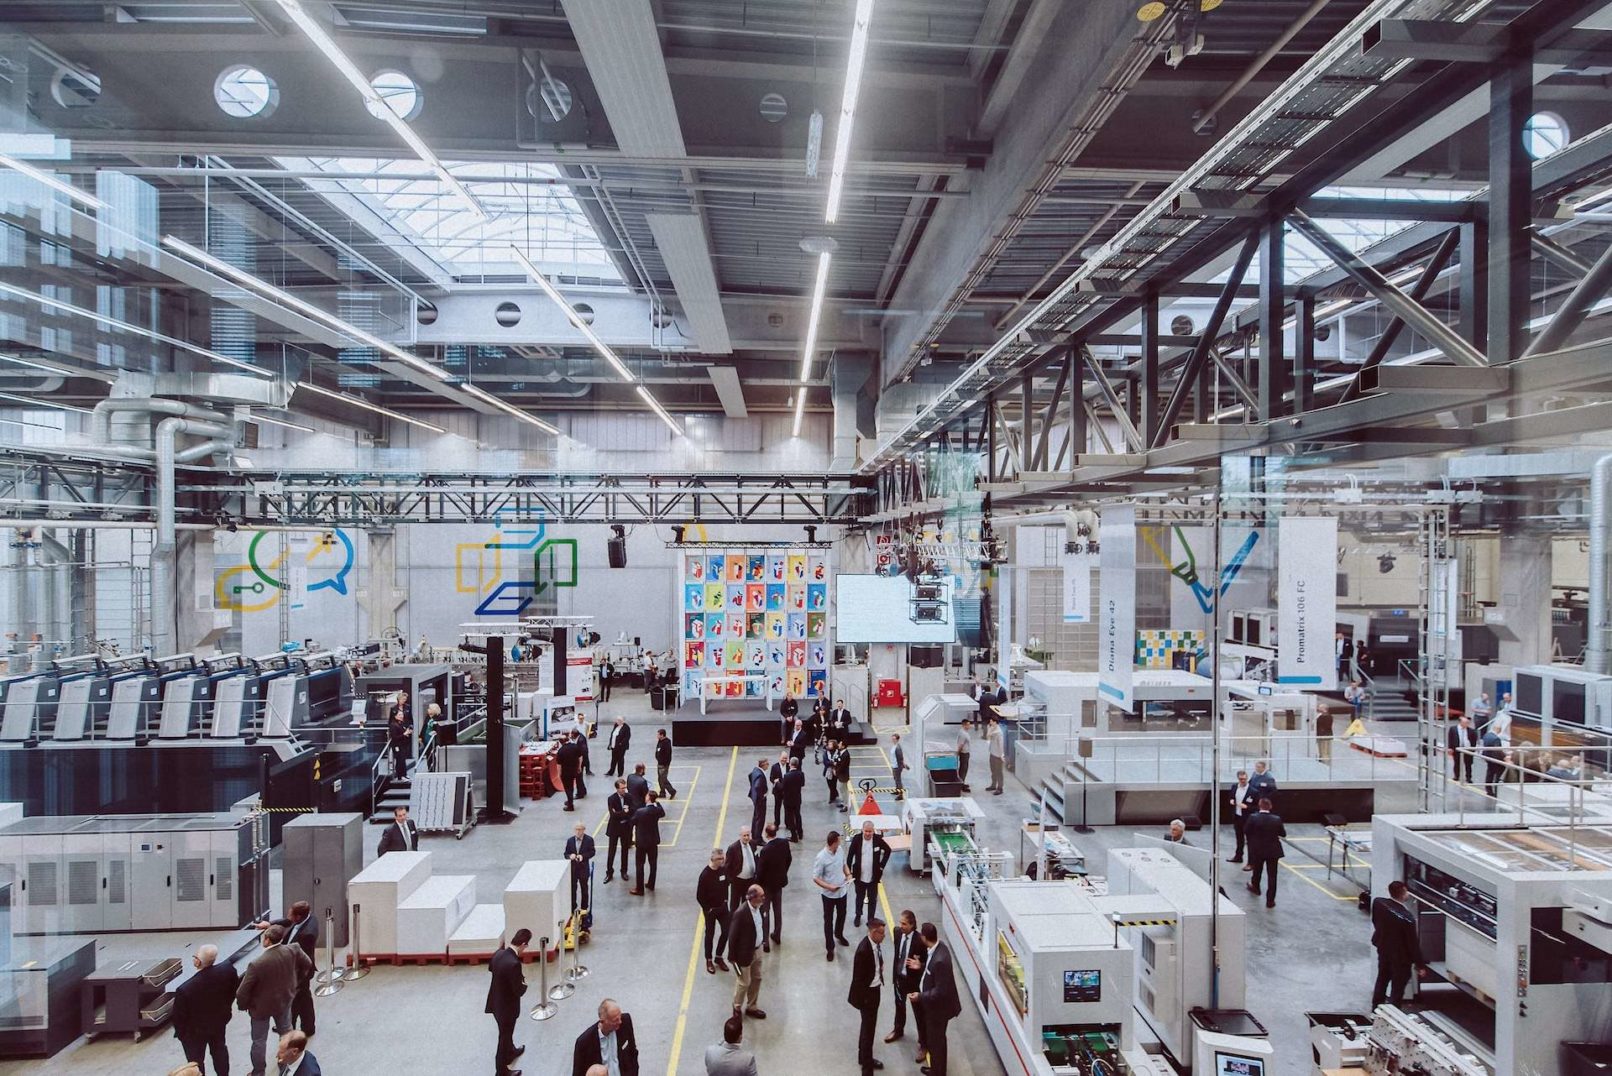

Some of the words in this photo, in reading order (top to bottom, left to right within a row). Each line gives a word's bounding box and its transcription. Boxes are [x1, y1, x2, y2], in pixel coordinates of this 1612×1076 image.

[1297, 580, 1306, 593] FC
[1109, 600, 1115, 613] 42
[1297, 596, 1305, 613] 106
[1297, 616, 1305, 663] Promatrix
